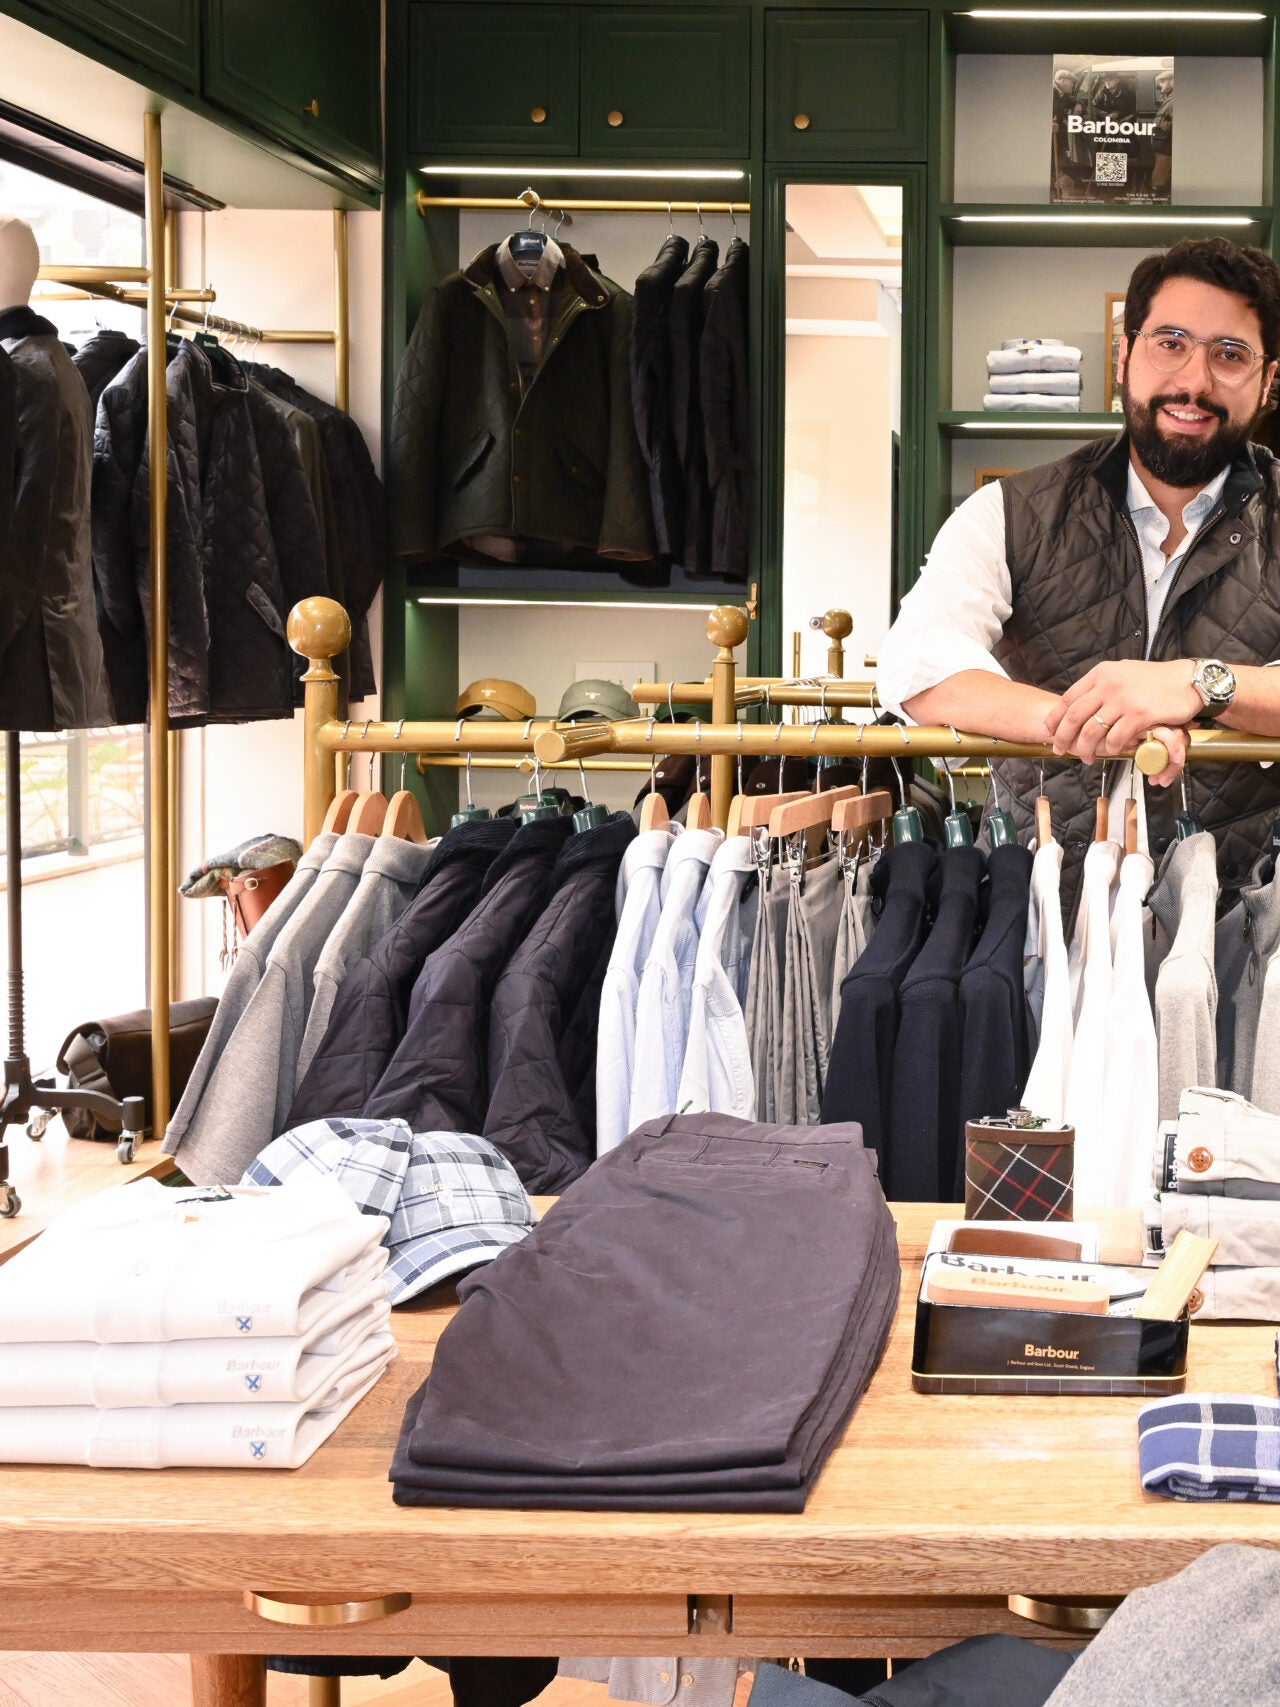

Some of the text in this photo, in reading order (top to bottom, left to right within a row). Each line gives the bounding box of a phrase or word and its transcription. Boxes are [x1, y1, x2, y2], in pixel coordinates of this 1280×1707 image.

[1067, 115, 1157, 136] Barbour
[1024, 1343, 1079, 1359] Barbour
[226, 1359, 281, 1372] Barbour
[231, 1424, 286, 1439] Barbour
